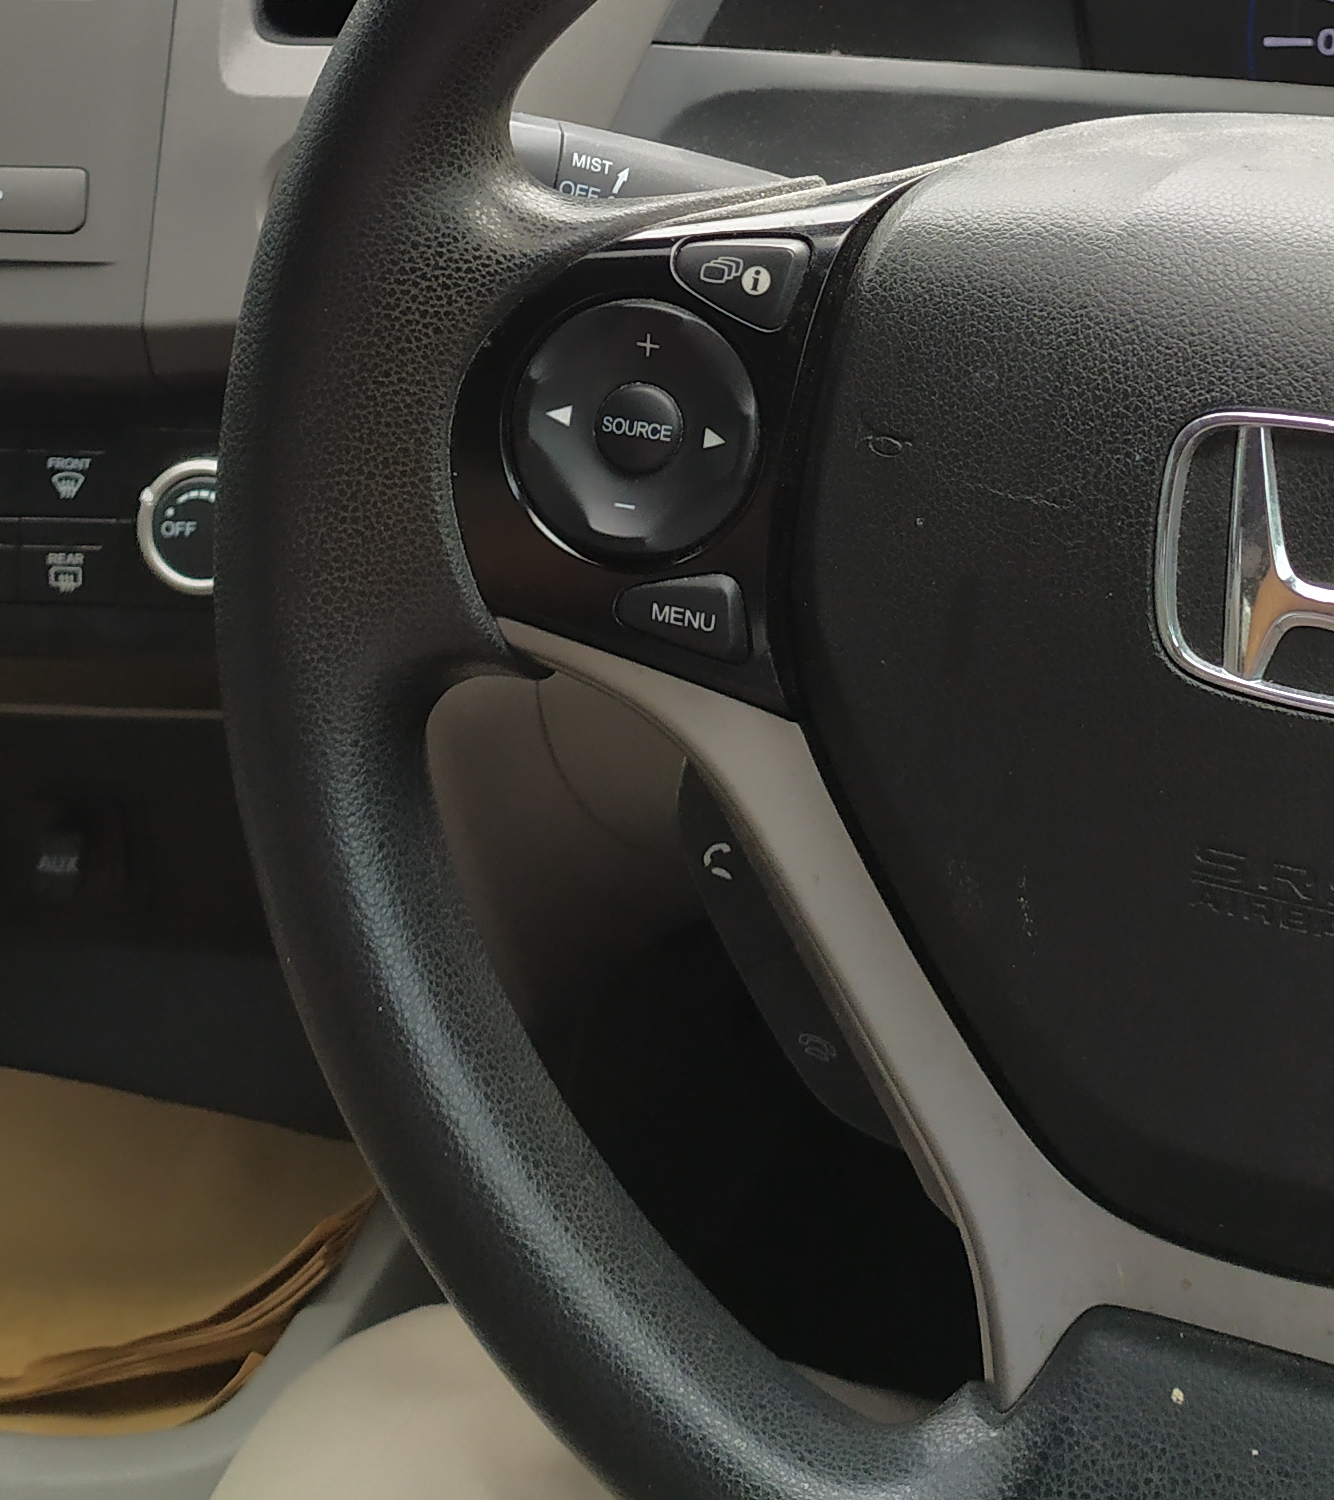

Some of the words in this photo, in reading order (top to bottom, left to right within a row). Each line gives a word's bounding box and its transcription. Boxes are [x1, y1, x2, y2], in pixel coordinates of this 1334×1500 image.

[572, 152, 613, 175] MIST
[602, 415, 673, 442] SOURCE
[46, 457, 93, 470] FRONT
[160, 520, 198, 539] OFF
[46, 553, 85, 565] REAR
[651, 602, 716, 632] MENU
